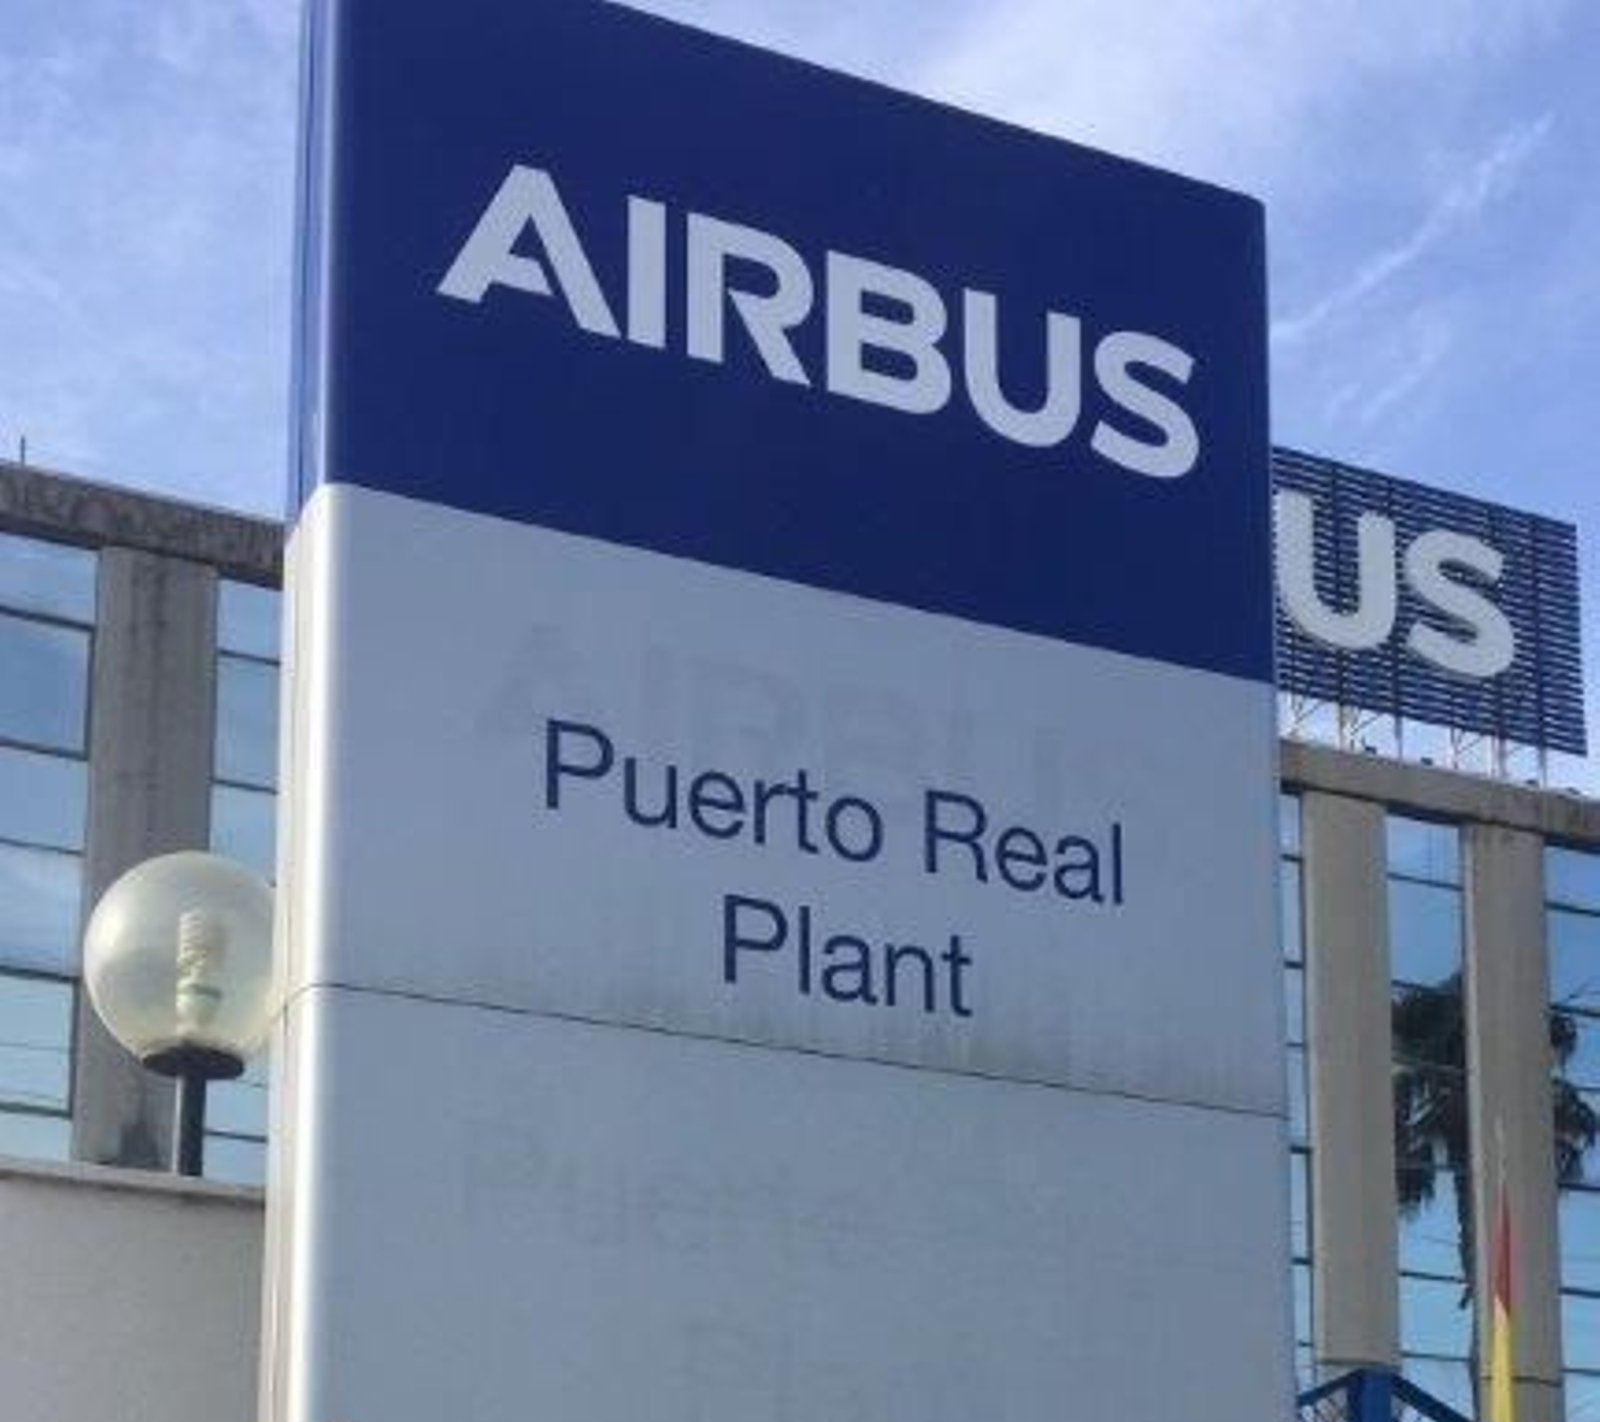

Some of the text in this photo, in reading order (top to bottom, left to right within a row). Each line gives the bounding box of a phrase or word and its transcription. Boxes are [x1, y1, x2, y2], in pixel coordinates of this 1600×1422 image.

[438, 163, 1201, 479] AIRBUS
[546, 718, 1124, 906] Puerto Real
[724, 894, 972, 1017] Plant
